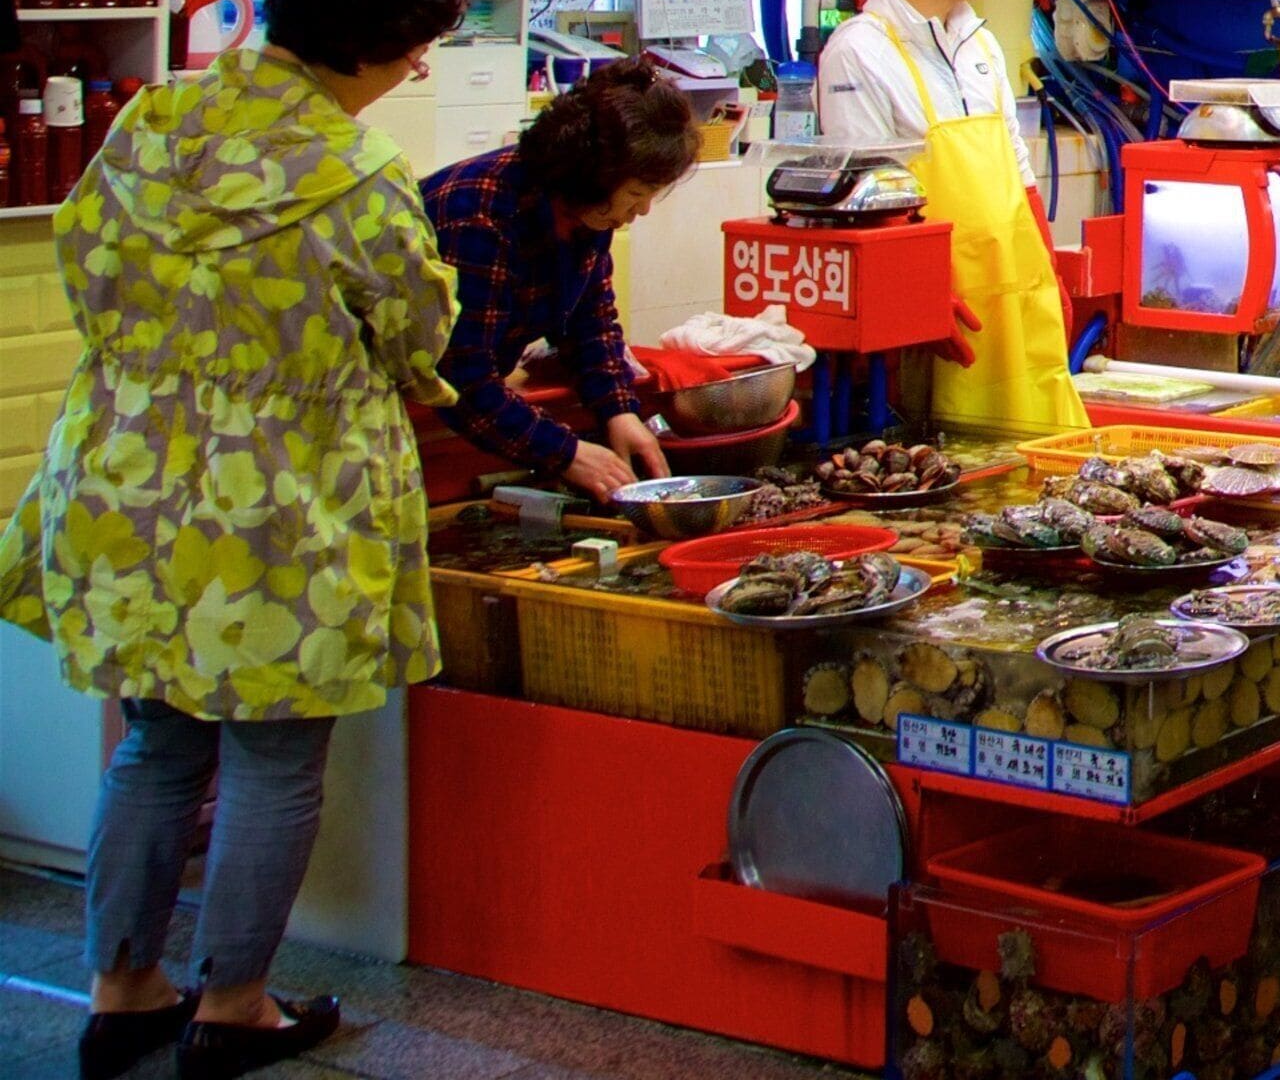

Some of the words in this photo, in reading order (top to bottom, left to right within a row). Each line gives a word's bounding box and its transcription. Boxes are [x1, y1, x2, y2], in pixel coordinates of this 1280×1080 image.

[732, 239, 850, 312] 영도상회
[903, 718, 928, 736] 원산지
[978, 733, 1004, 750] 원산지
[1055, 746, 1082, 763] 원산지
